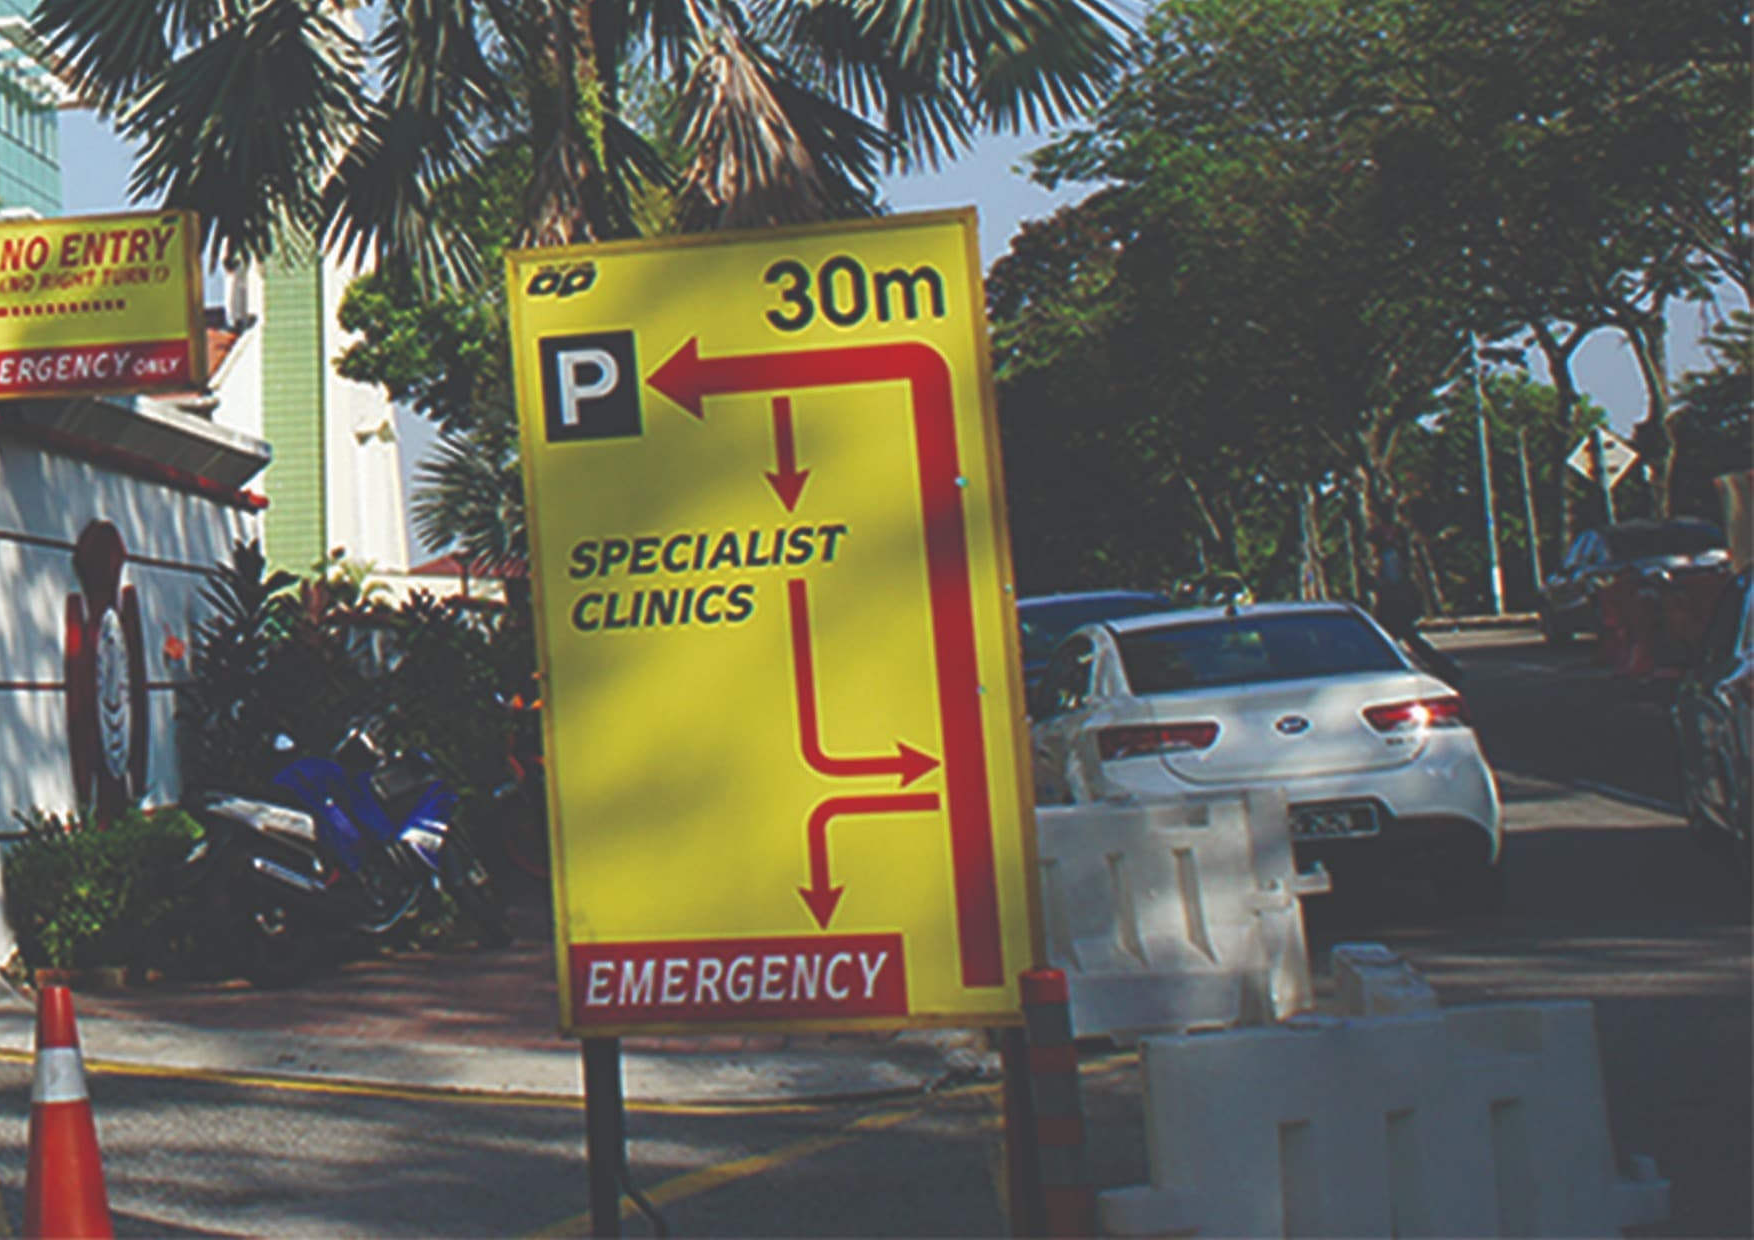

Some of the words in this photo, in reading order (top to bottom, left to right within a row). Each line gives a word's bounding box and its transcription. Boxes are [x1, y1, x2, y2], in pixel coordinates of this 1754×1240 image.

[58, 226, 175, 268] ENTRY
[763, 255, 946, 331] 30m
[133, 357, 181, 376] ONLY
[557, 348, 619, 425] P
[568, 525, 848, 578] SPECIALIST
[572, 584, 754, 631] CLINICS
[586, 952, 888, 1006] EMERGENCY
